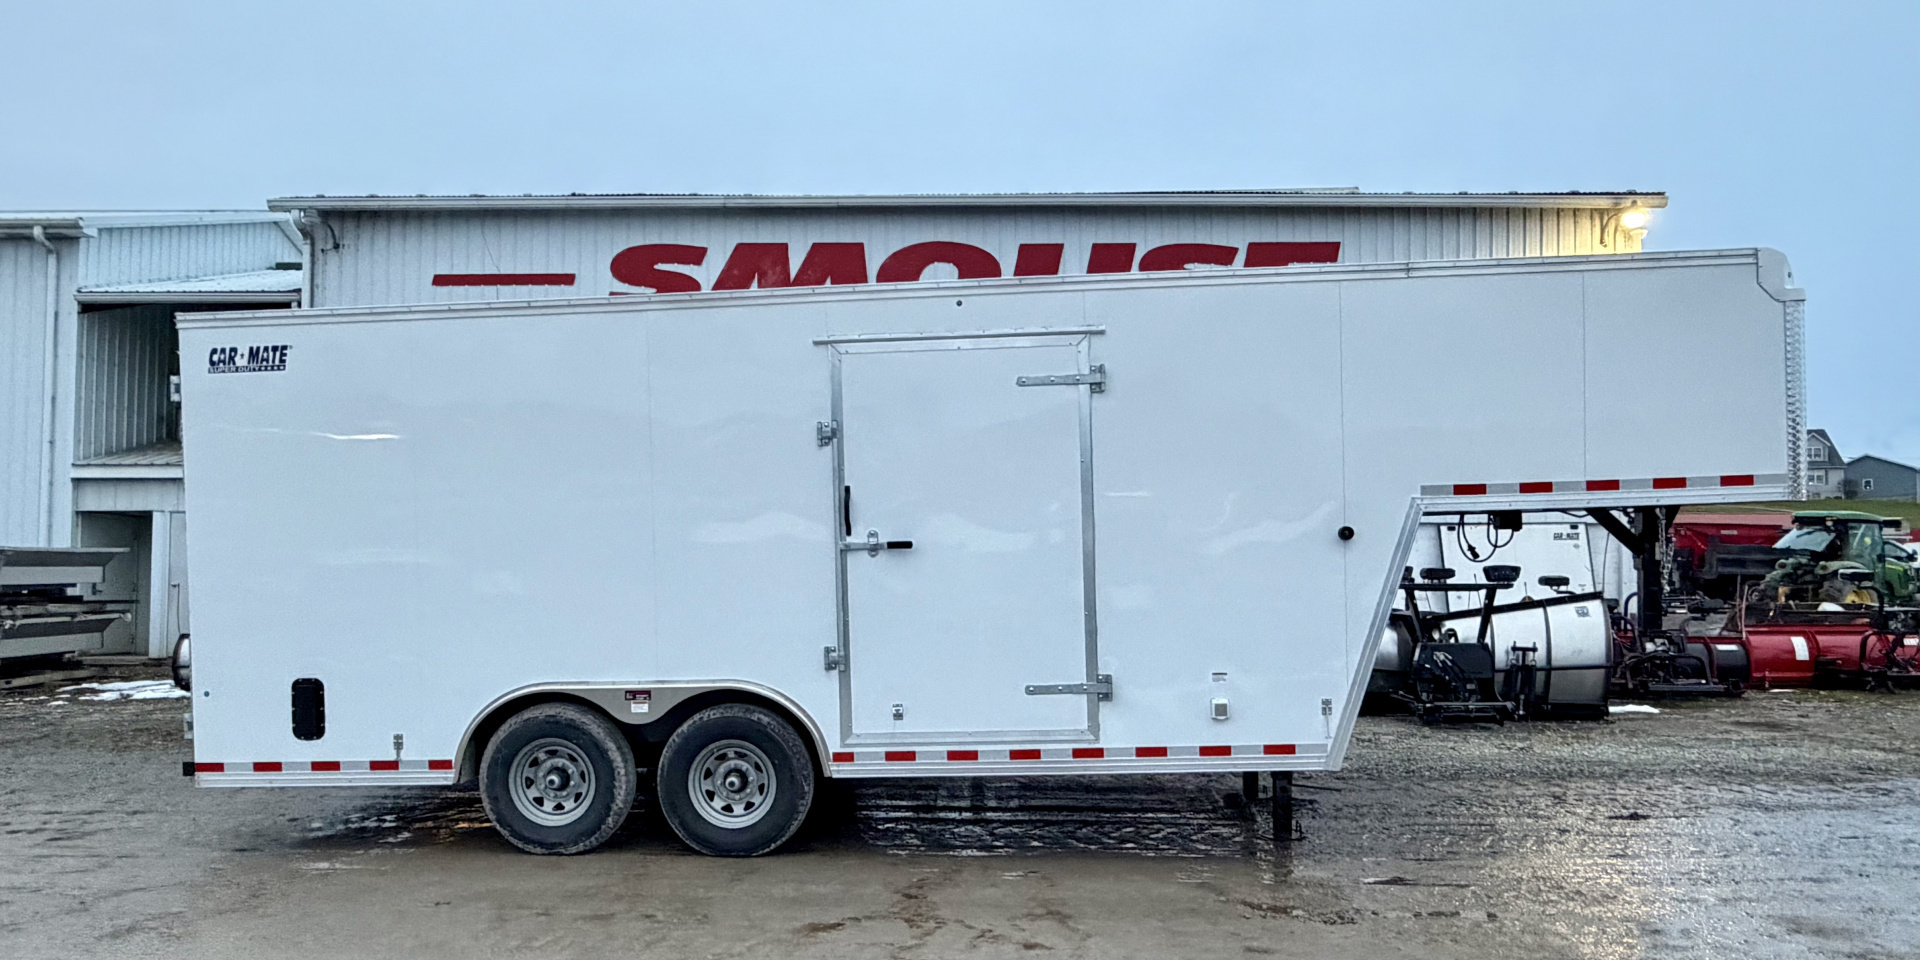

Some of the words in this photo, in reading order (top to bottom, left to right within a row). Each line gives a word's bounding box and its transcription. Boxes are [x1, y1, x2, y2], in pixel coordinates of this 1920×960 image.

[208, 347, 238, 367] CAR
[247, 345, 288, 365] MATE
[208, 366, 236, 374] SUPER
